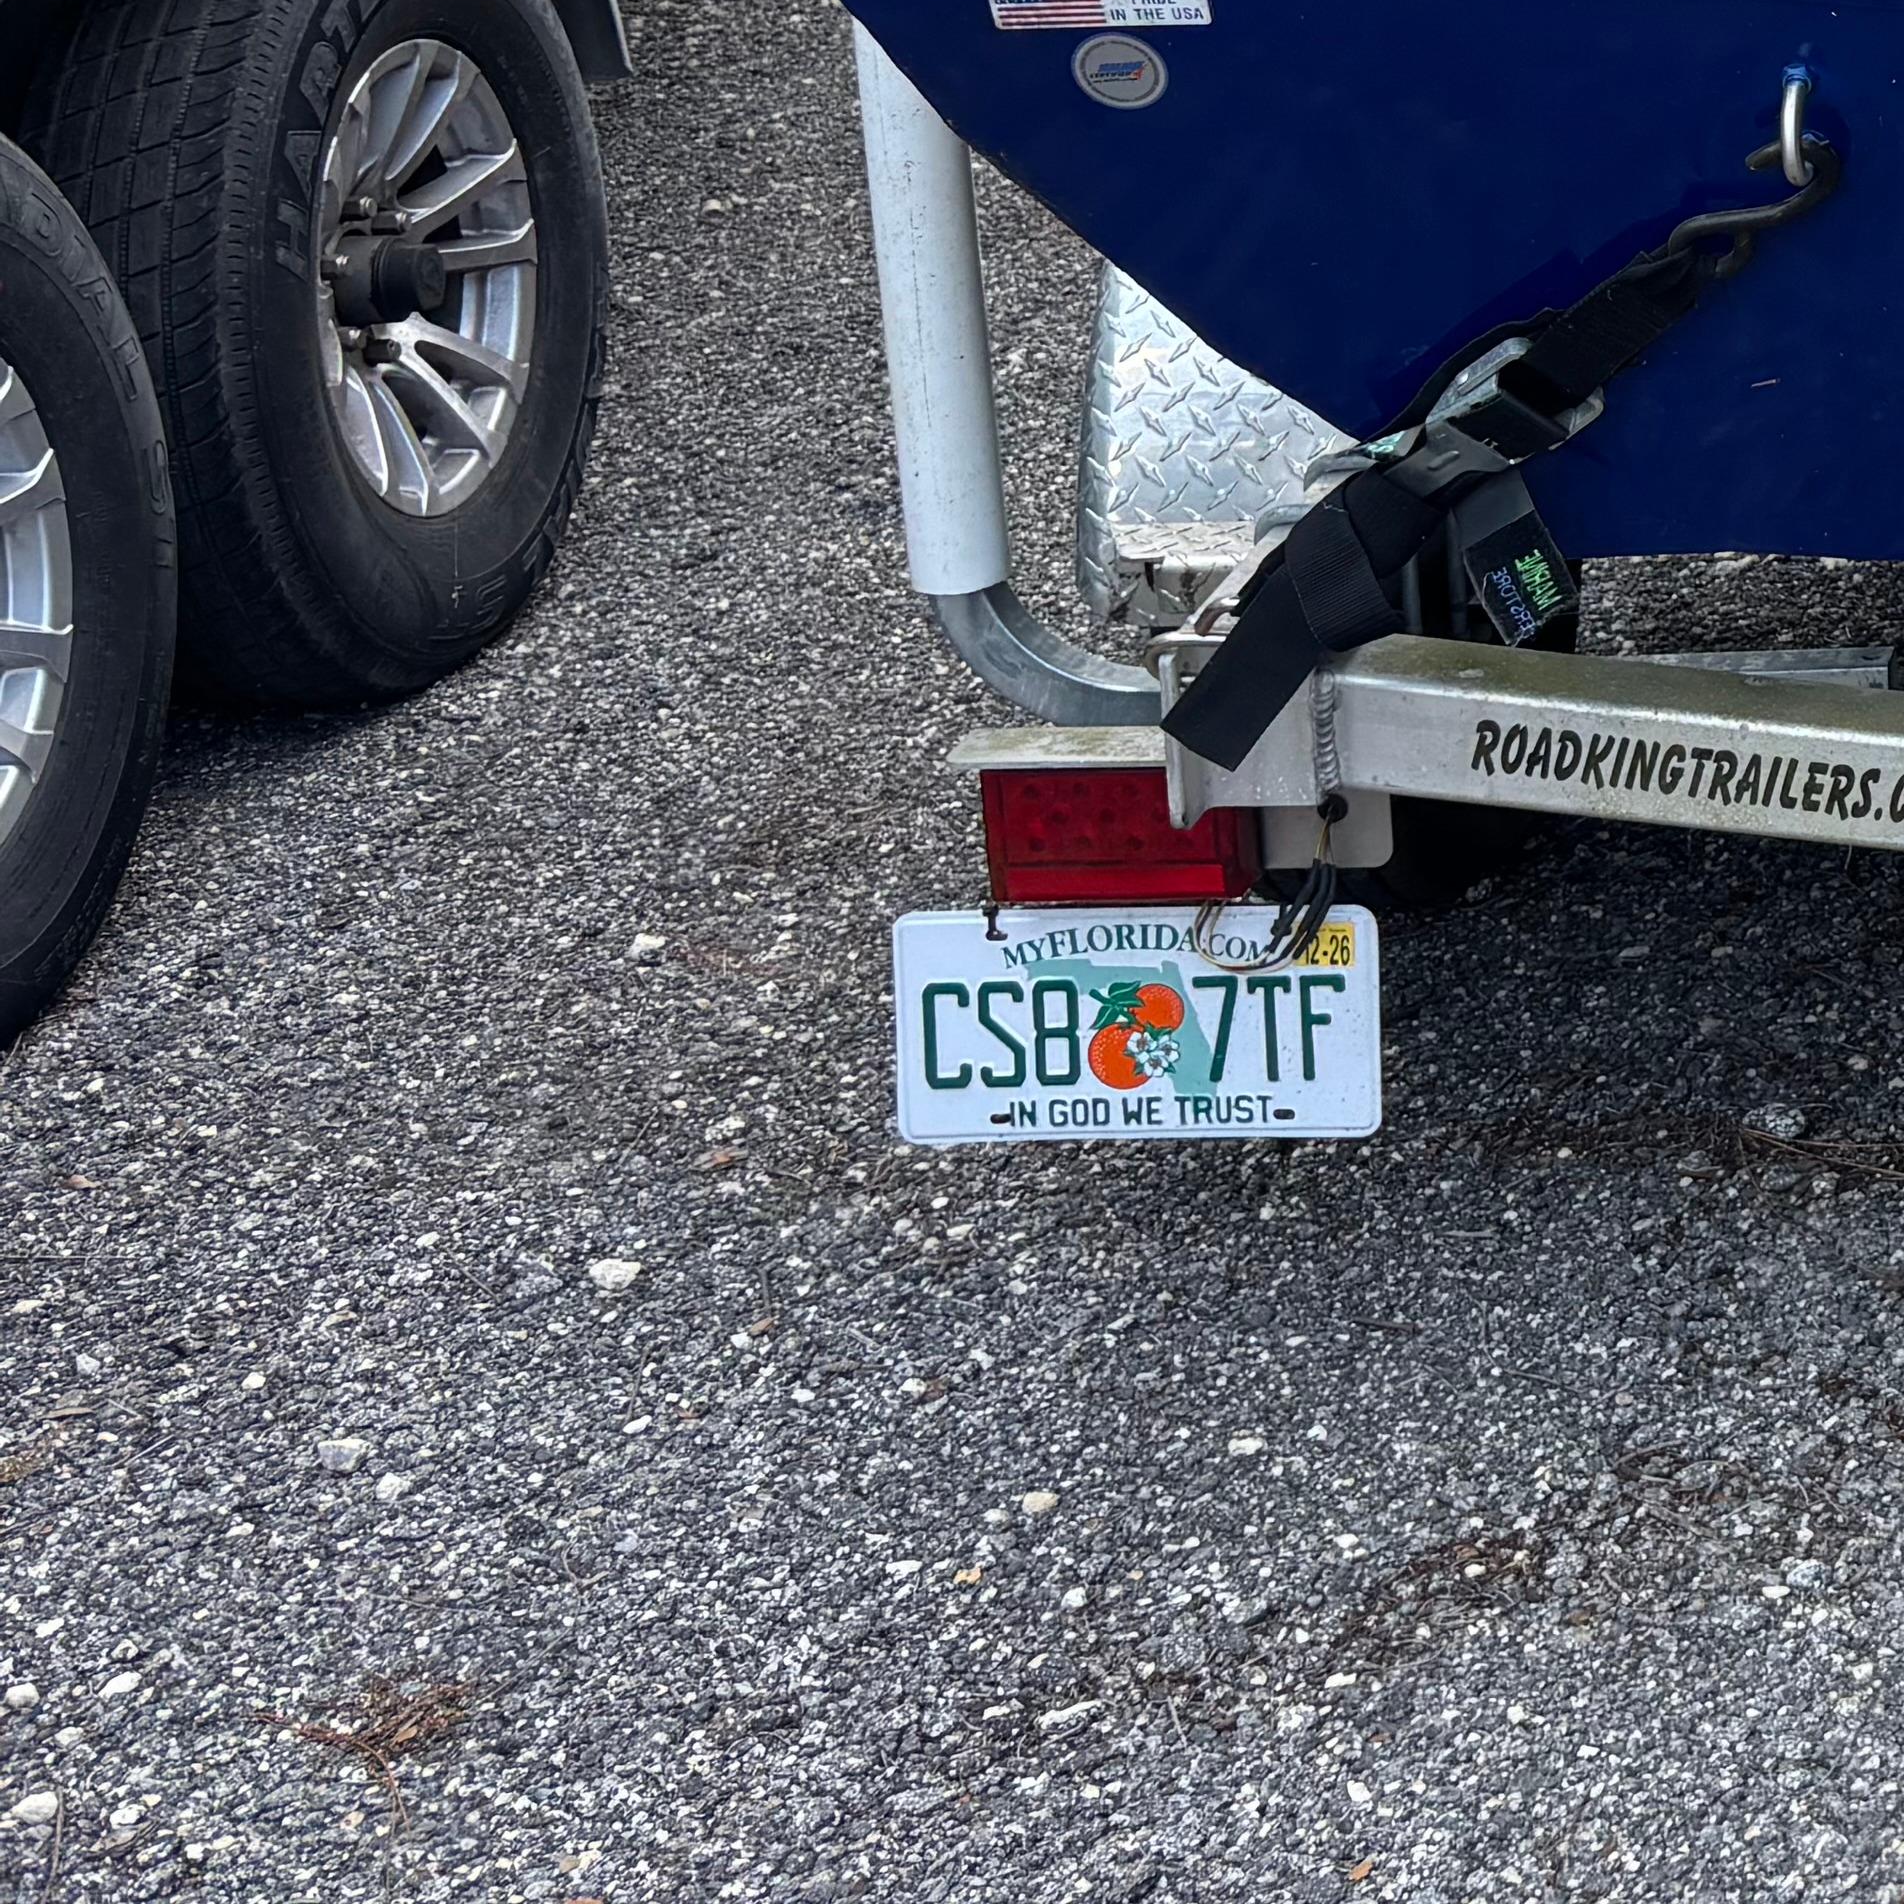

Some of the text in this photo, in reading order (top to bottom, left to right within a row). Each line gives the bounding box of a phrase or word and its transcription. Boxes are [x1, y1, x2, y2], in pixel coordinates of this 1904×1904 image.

[1110, 6, 1205, 22] IN THE USA
[921, 973, 1347, 1090] CS8 7TF
[1009, 1094, 1273, 1127] IN GOD WE TRUST
